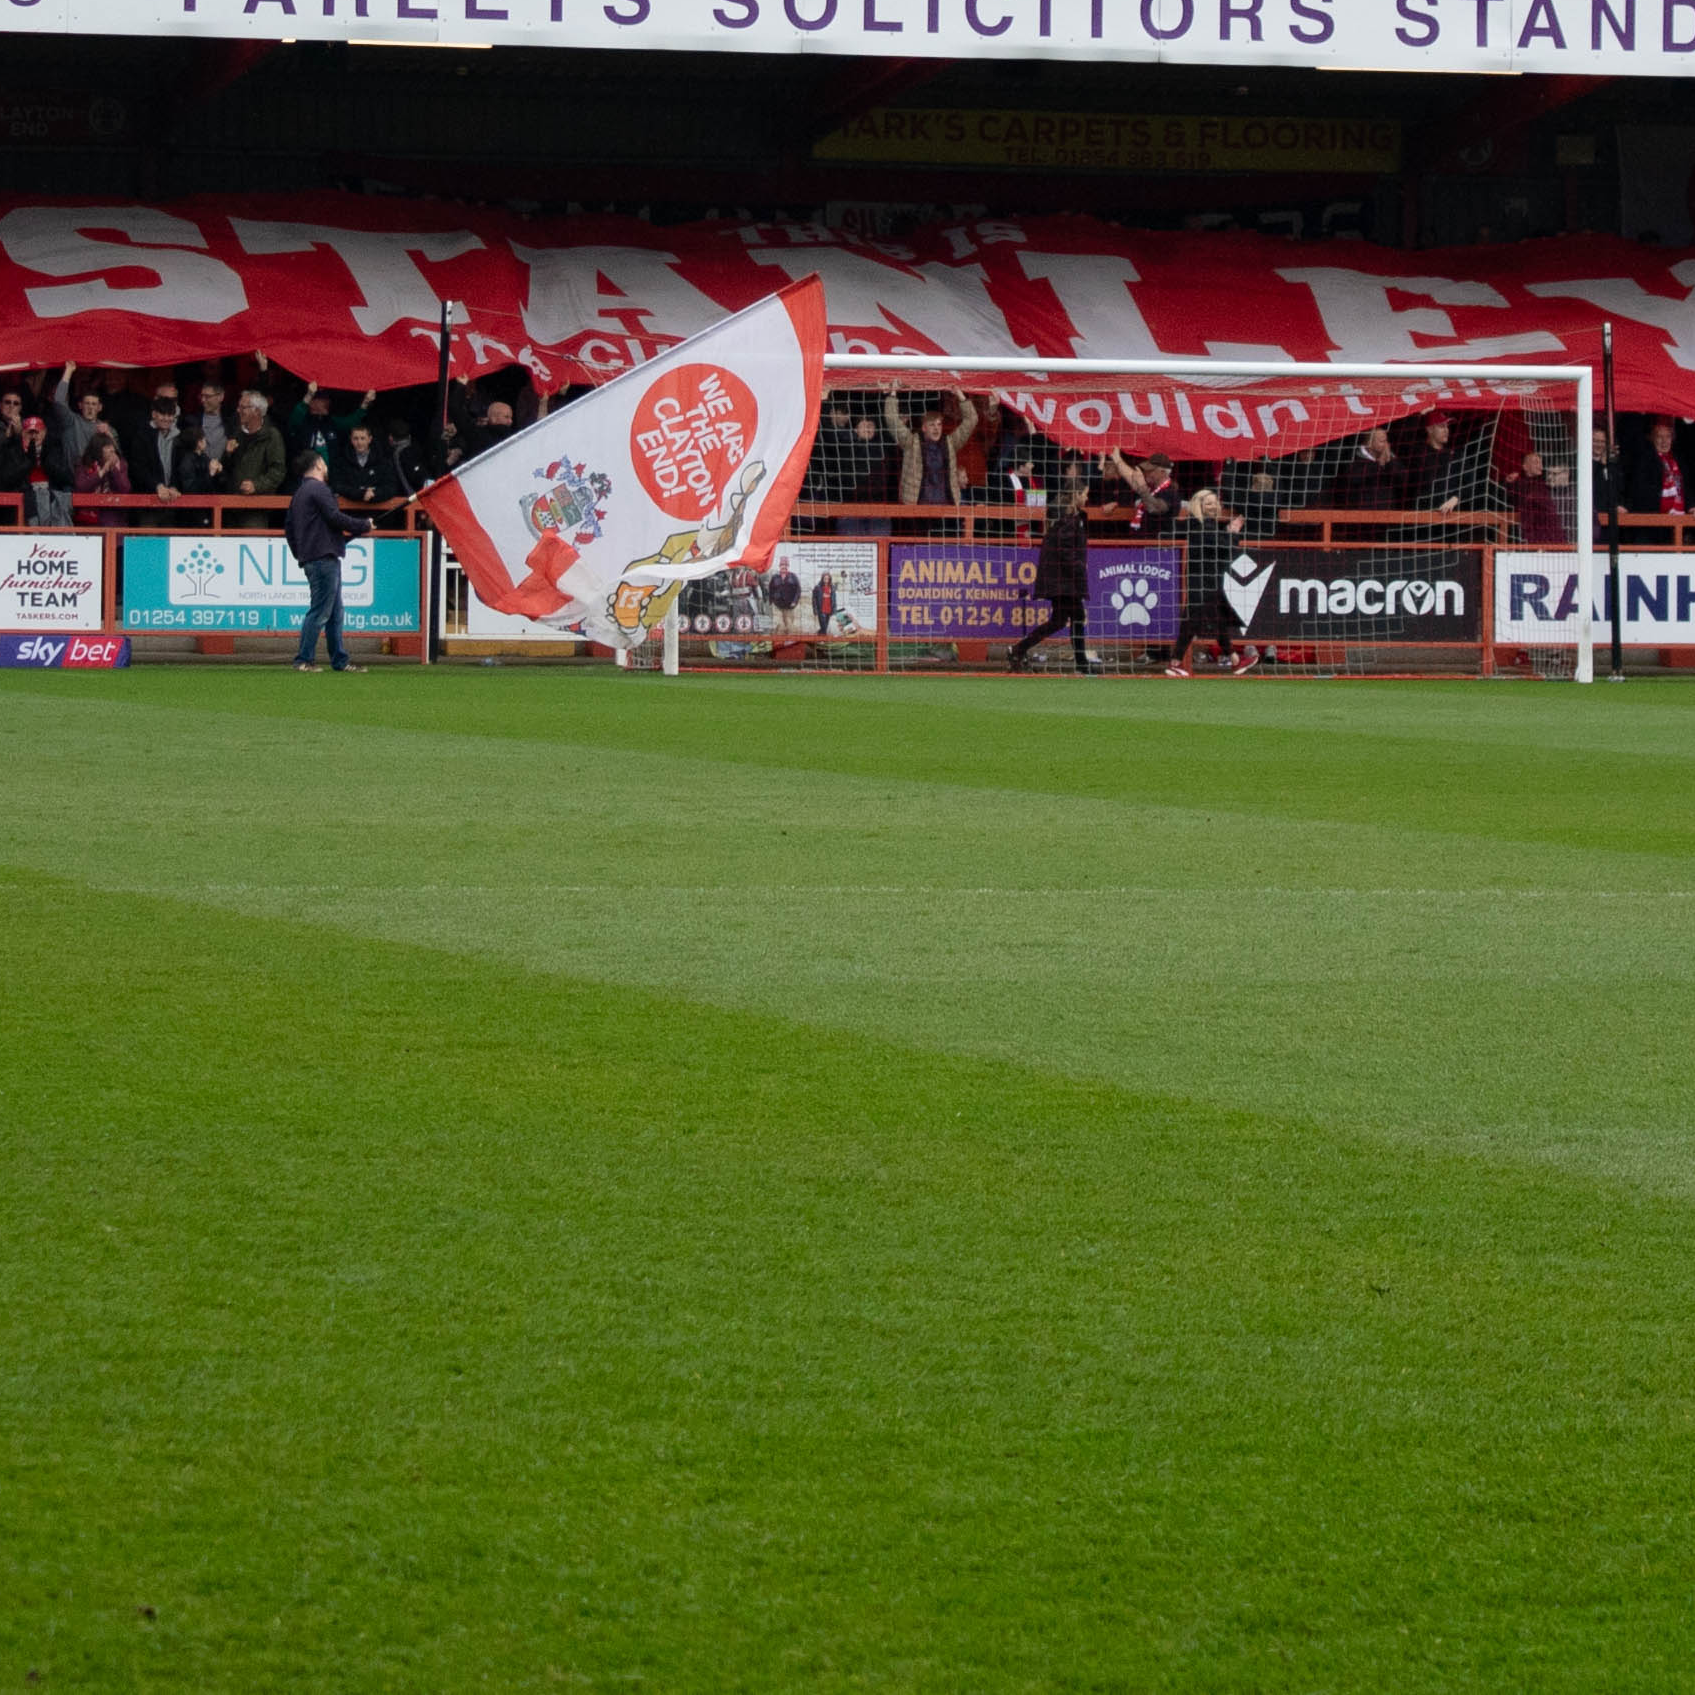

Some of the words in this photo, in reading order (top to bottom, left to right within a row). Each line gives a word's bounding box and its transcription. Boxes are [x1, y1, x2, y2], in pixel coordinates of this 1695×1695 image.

[978, 114, 1152, 147] CARPETS
[1163, 117, 1187, 147] &
[1200, 120, 1394, 153] FLOORING
[698, 372, 733, 418] WE
[685, 402, 721, 455] THE
[653, 396, 717, 507] CLAYTON
[636, 431, 687, 499] END!
[27, 543, 70, 559] Your
[17, 560, 79, 576] HOME
[239, 544, 368, 587] NLG
[898, 560, 999, 585] ANIMAL
[1099, 563, 1137, 580] ANIMAL
[1138, 563, 1172, 581] LODGE
[0, 573, 93, 596] furnishing
[897, 587, 962, 600] BOARDING
[965, 589, 1019, 601] KENNELS
[16, 593, 78, 608] TEAM
[1279, 578, 1465, 616] macron
[16, 613, 79, 621] TASKERS.COM
[129, 609, 188, 626] 01254
[191, 610, 260, 627] 397119
[290, 612, 414, 629] wltg.co.uk
[898, 606, 935, 625] TEL
[940, 607, 1005, 626] 01254
[16, 635, 67, 663] sky
[70, 637, 118, 662] bet
